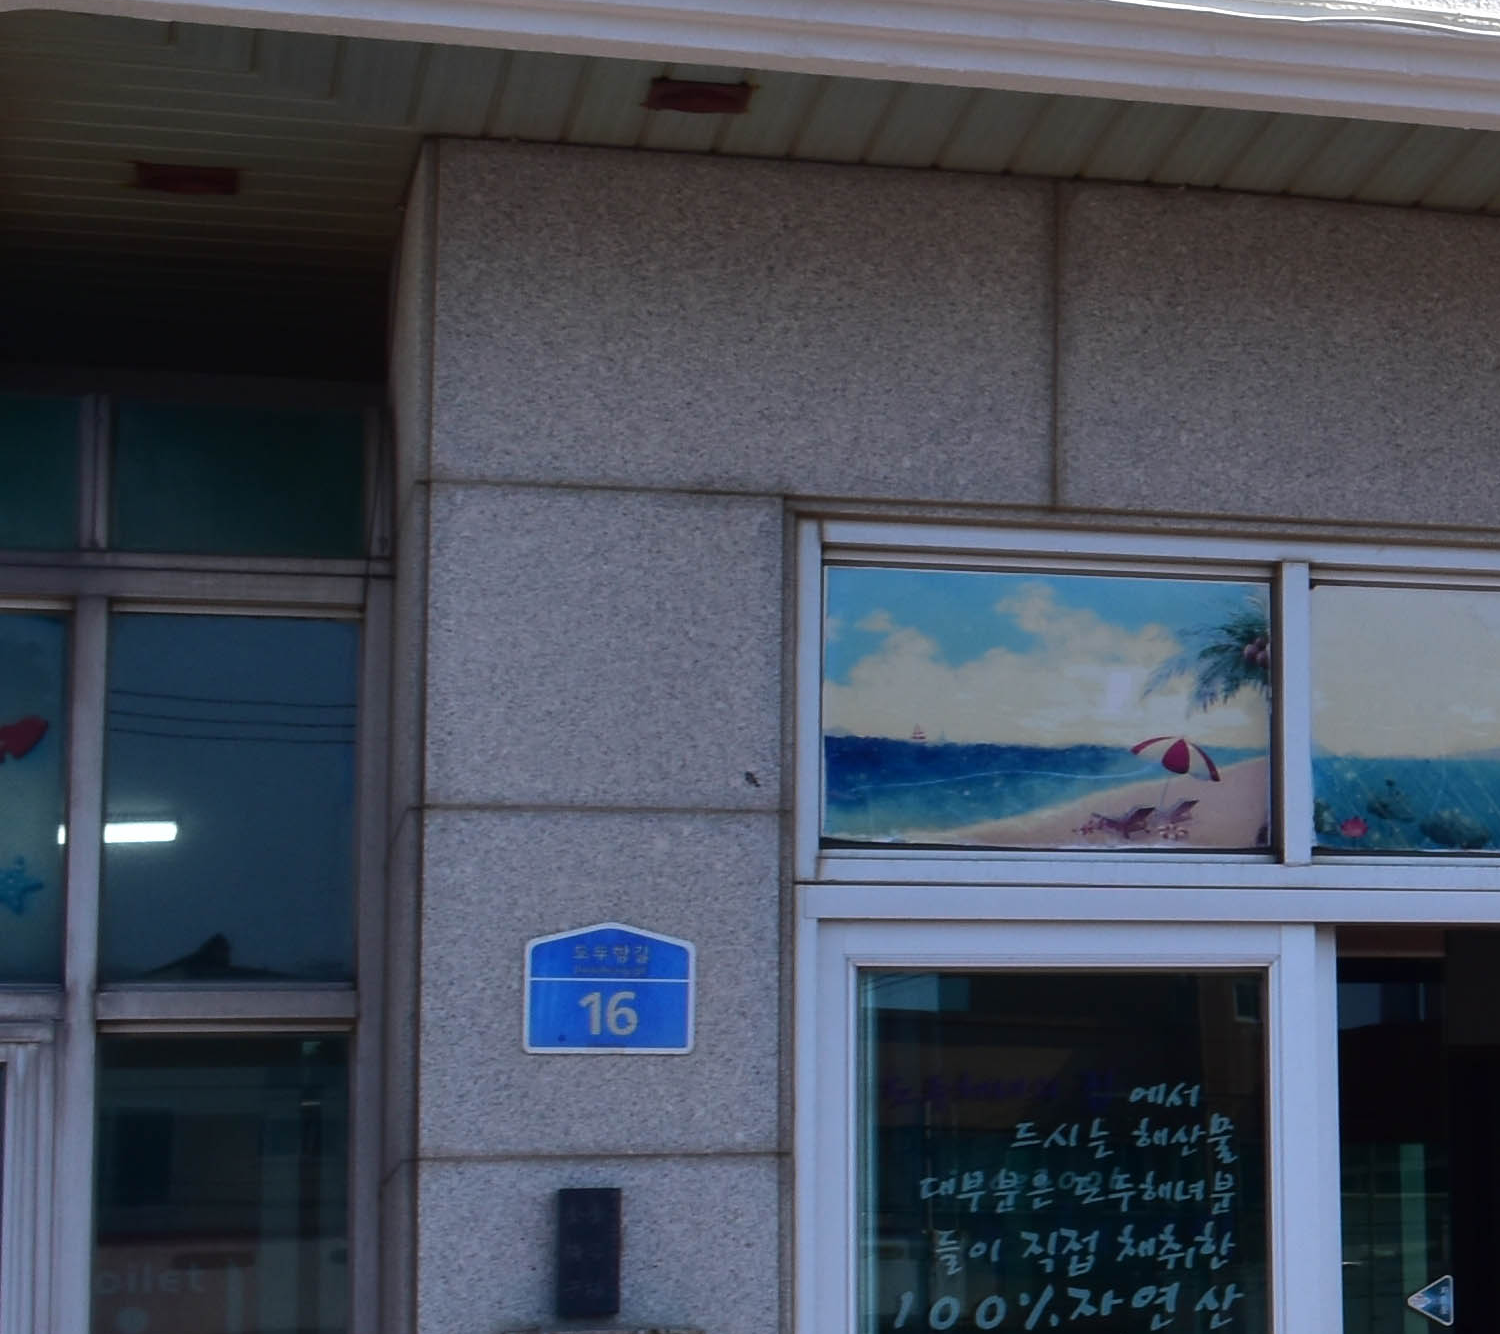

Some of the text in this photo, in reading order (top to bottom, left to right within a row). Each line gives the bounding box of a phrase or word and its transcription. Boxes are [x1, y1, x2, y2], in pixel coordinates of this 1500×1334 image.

[578, 991, 638, 1035] 16
[1128, 1083, 1200, 1108] 에서
[1011, 1113, 1238, 1164] 드시는 해산물
[920, 1169, 1054, 1214] 대부분은
[935, 1221, 1236, 1277] 들이 직접 채취한
[97, 1261, 206, 1297] oilet
